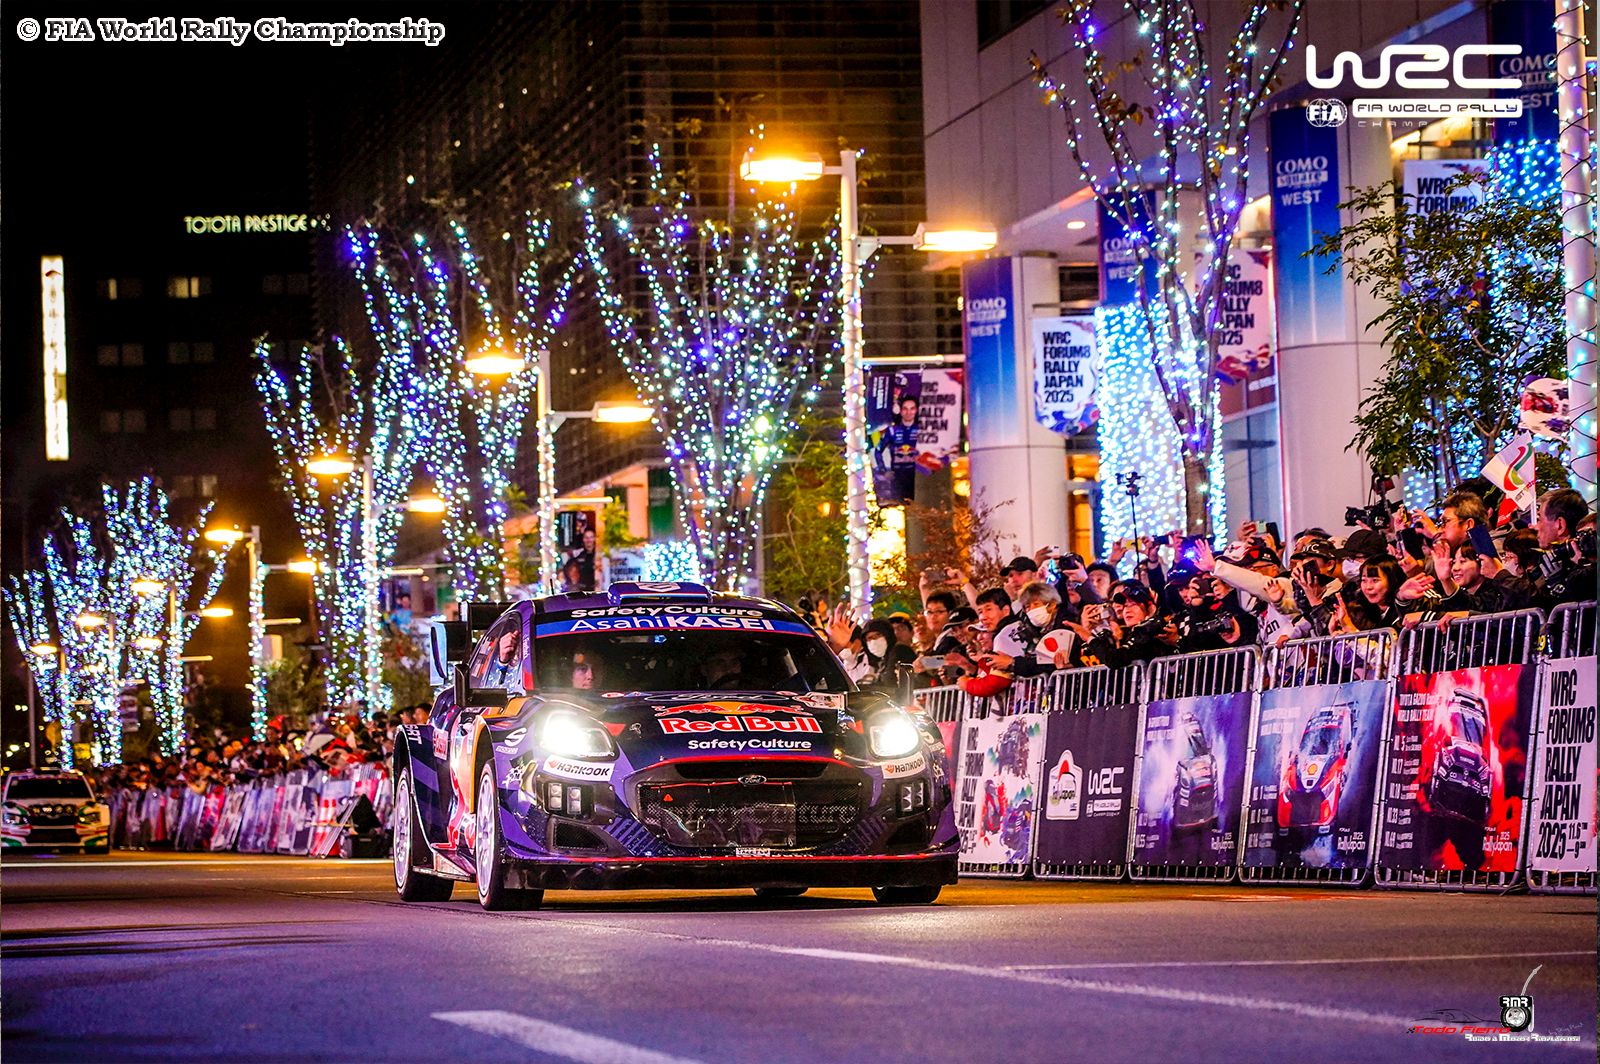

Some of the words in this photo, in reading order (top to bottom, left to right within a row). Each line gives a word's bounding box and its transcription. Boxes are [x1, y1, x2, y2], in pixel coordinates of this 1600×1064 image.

[1276, 156, 1328, 175] COMO
[1281, 190, 1322, 206] WEST
[244, 213, 308, 233] PRESTIGE
[1043, 331, 1072, 345] WRC
[1043, 345, 1091, 359] FORUM8
[1044, 360, 1080, 374] RALLY
[1044, 374, 1083, 388] JAPAN
[1044, 390, 1075, 404] 2025
[571, 605, 763, 618] SafetyCulture
[1550, 669, 1577, 707] WRC
[658, 716, 745, 735] Red
[742, 715, 823, 734] Bull
[1546, 706, 1596, 745] FORUM8
[688, 738, 812, 751] SafetyCulture
[1544, 746, 1581, 782] RALLY
[1088, 766, 1125, 796] WRC
[1539, 784, 1581, 821] JAPAN
[1536, 821, 1568, 860] 2025
